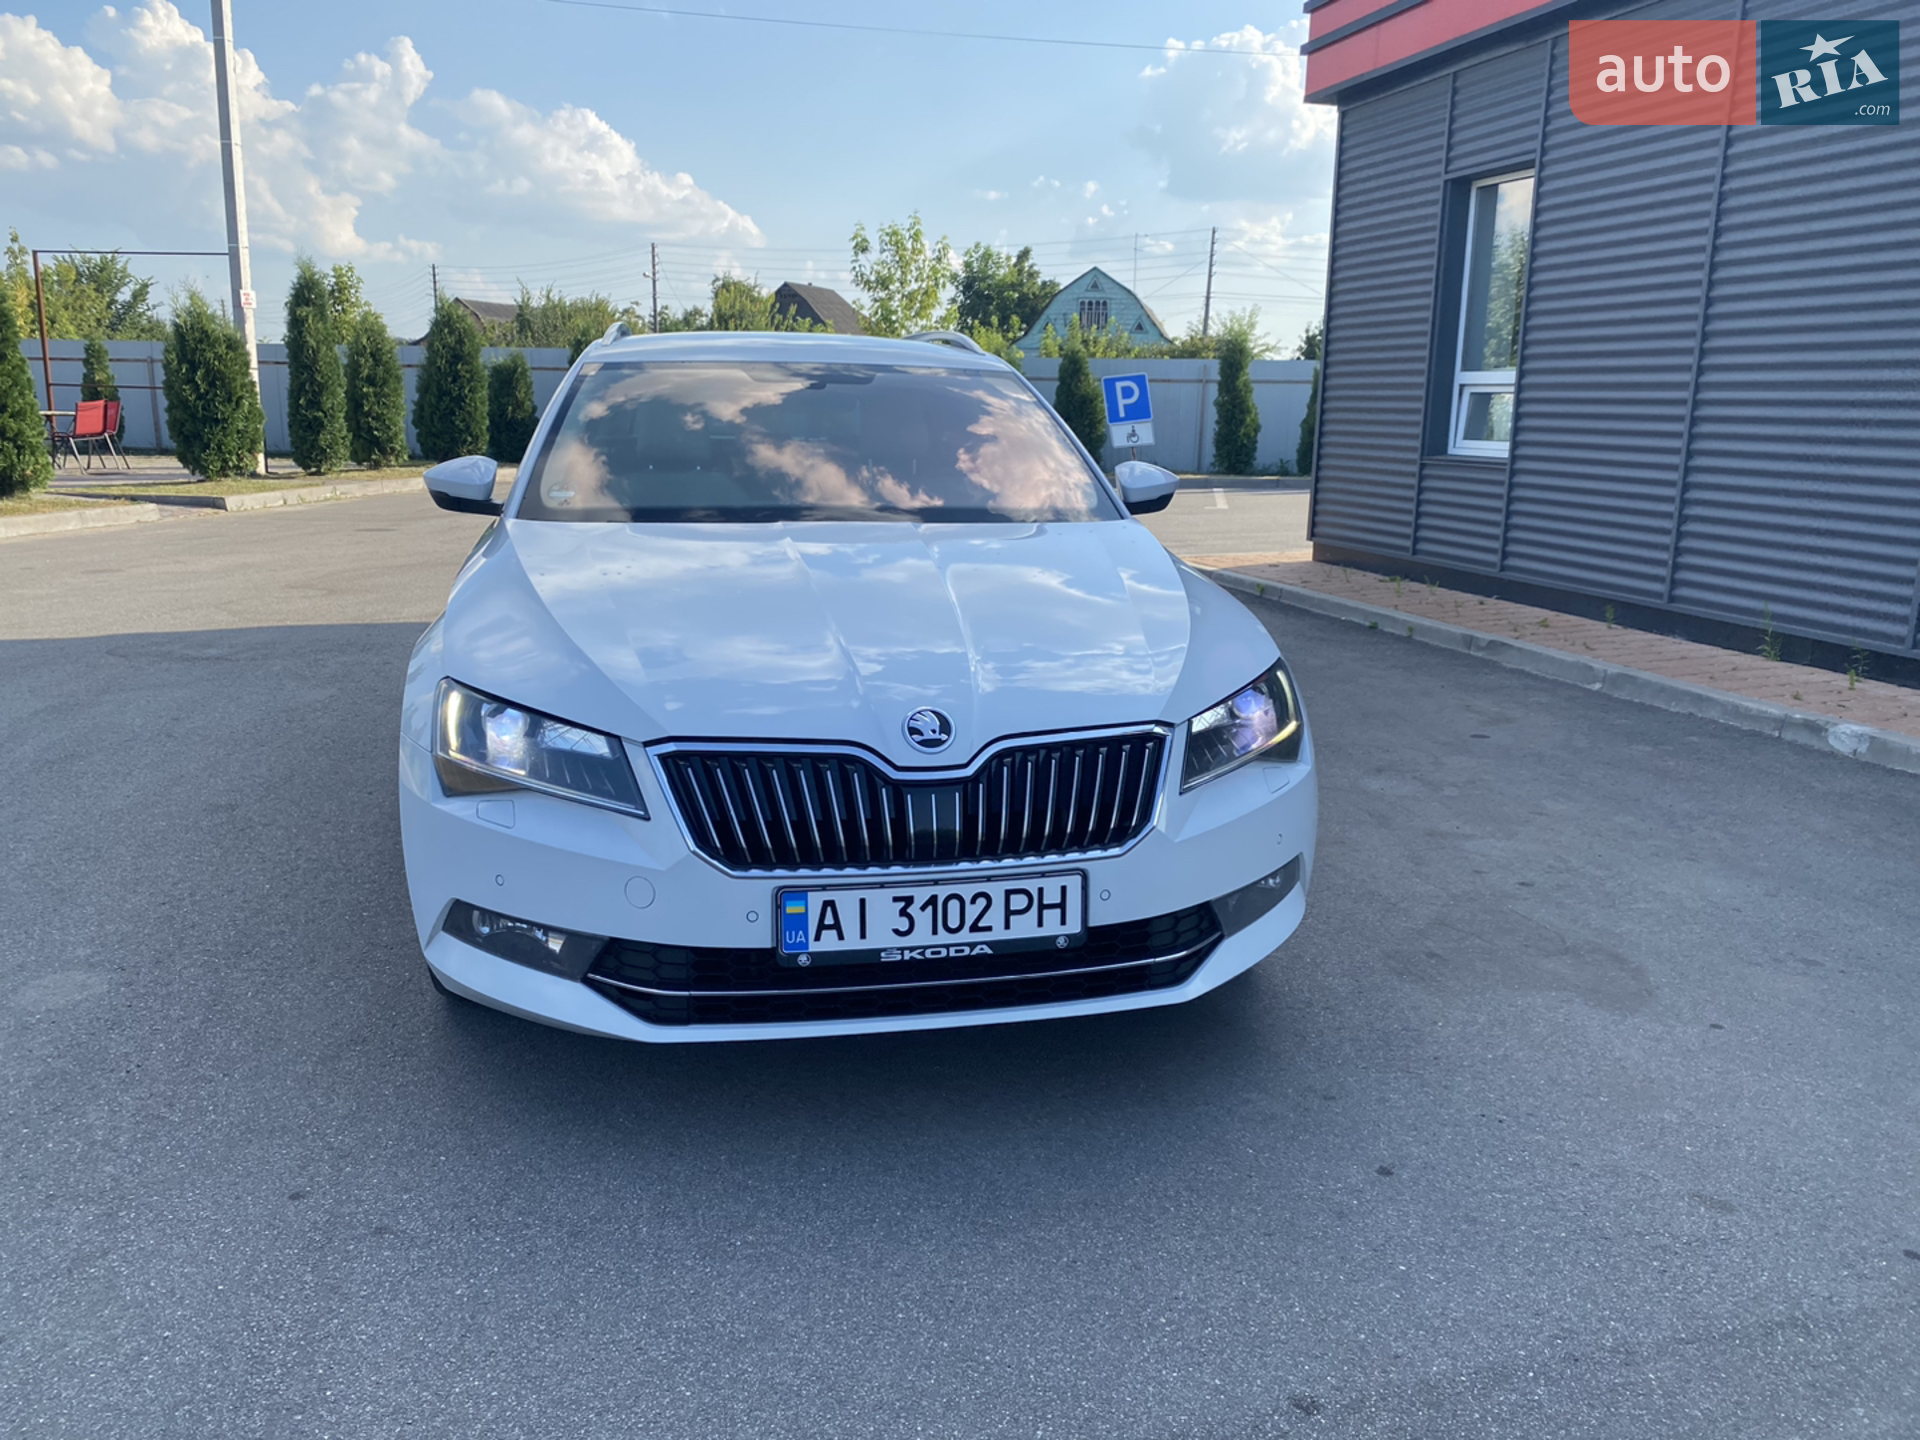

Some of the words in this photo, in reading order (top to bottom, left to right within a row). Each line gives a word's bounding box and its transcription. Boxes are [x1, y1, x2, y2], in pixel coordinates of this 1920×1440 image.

[1115, 380, 1140, 418] P
[813, 897, 867, 942] AI
[891, 891, 994, 938] 3102
[786, 930, 806, 944] UA
